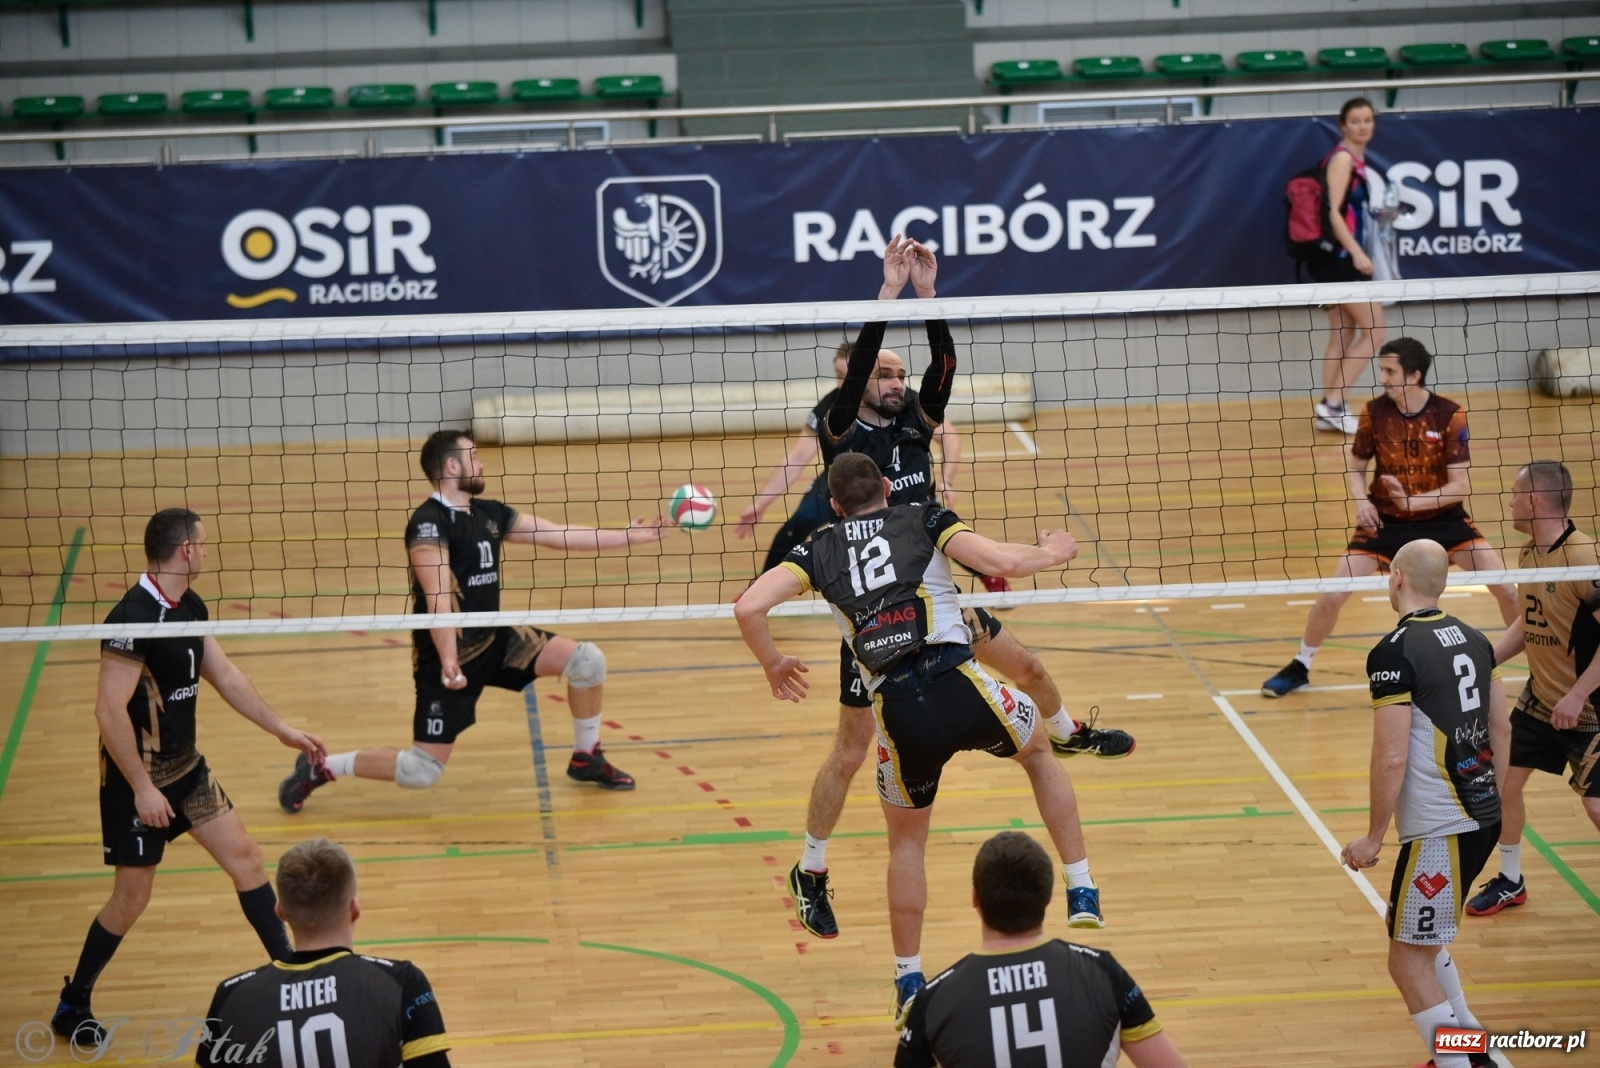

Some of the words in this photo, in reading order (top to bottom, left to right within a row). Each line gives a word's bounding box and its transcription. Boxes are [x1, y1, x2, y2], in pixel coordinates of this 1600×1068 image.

[793, 183, 1157, 262] RACIBÓRZ
[221, 204, 437, 280] OSiR
[1400, 229, 1523, 256] RACIBÓRZ
[309, 276, 438, 305] RACIBÓRZ
[885, 445, 901, 472] 4
[1402, 439, 1419, 458] 19
[890, 471, 925, 491] ROTIM
[477, 540, 494, 569] 10
[847, 535, 898, 597] 12
[864, 631, 912, 651] GRAVTON
[1433, 625, 1468, 648] ENTER
[1523, 631, 1562, 647] GROTIM
[188, 648, 196, 680] 1
[1371, 670, 1401, 682] VTON
[168, 683, 198, 702] AGROT
[849, 677, 862, 697] 4
[1452, 653, 1481, 713] 2
[427, 718, 443, 736] 10
[136, 836, 143, 856] 1
[1419, 876, 1435, 893] Enter
[1417, 906, 1436, 932] 2
[987, 960, 1048, 996] ENTER
[279, 975, 338, 1012] ENTER
[276, 1011, 351, 1068] 10
[989, 997, 1064, 1068] 14
